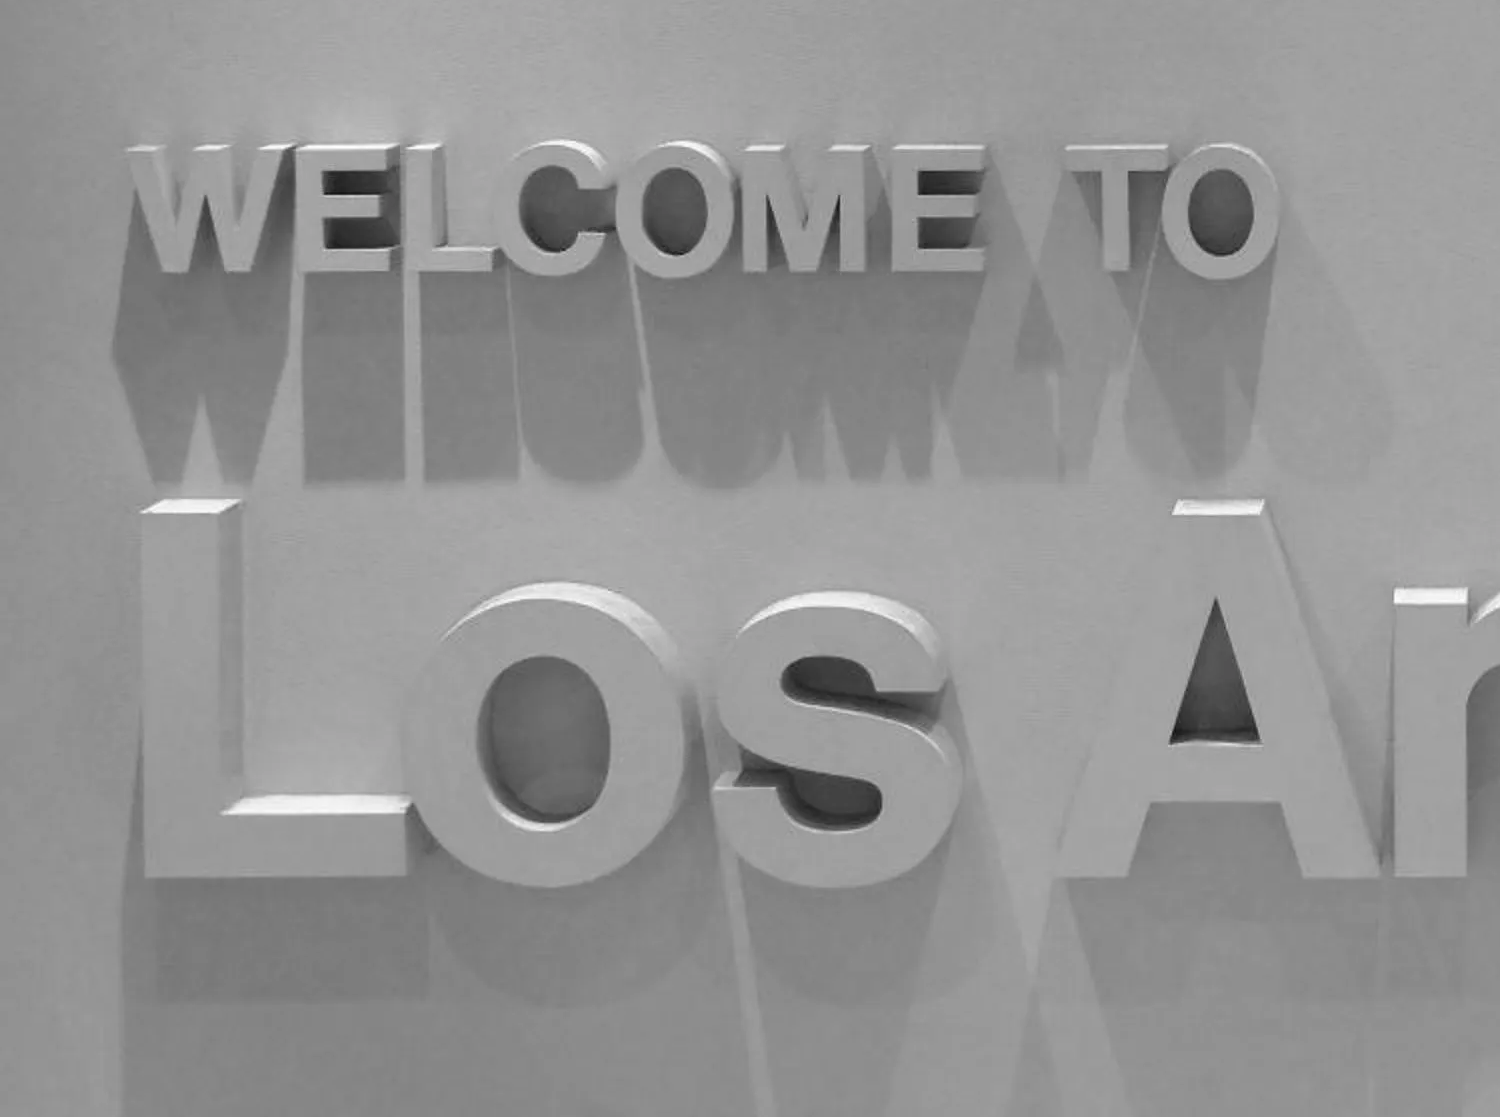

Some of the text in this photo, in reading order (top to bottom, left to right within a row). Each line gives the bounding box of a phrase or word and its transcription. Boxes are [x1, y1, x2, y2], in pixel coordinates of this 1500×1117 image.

[125, 140, 1281, 280] WELCOME TO
[141, 498, 961, 888] Los
